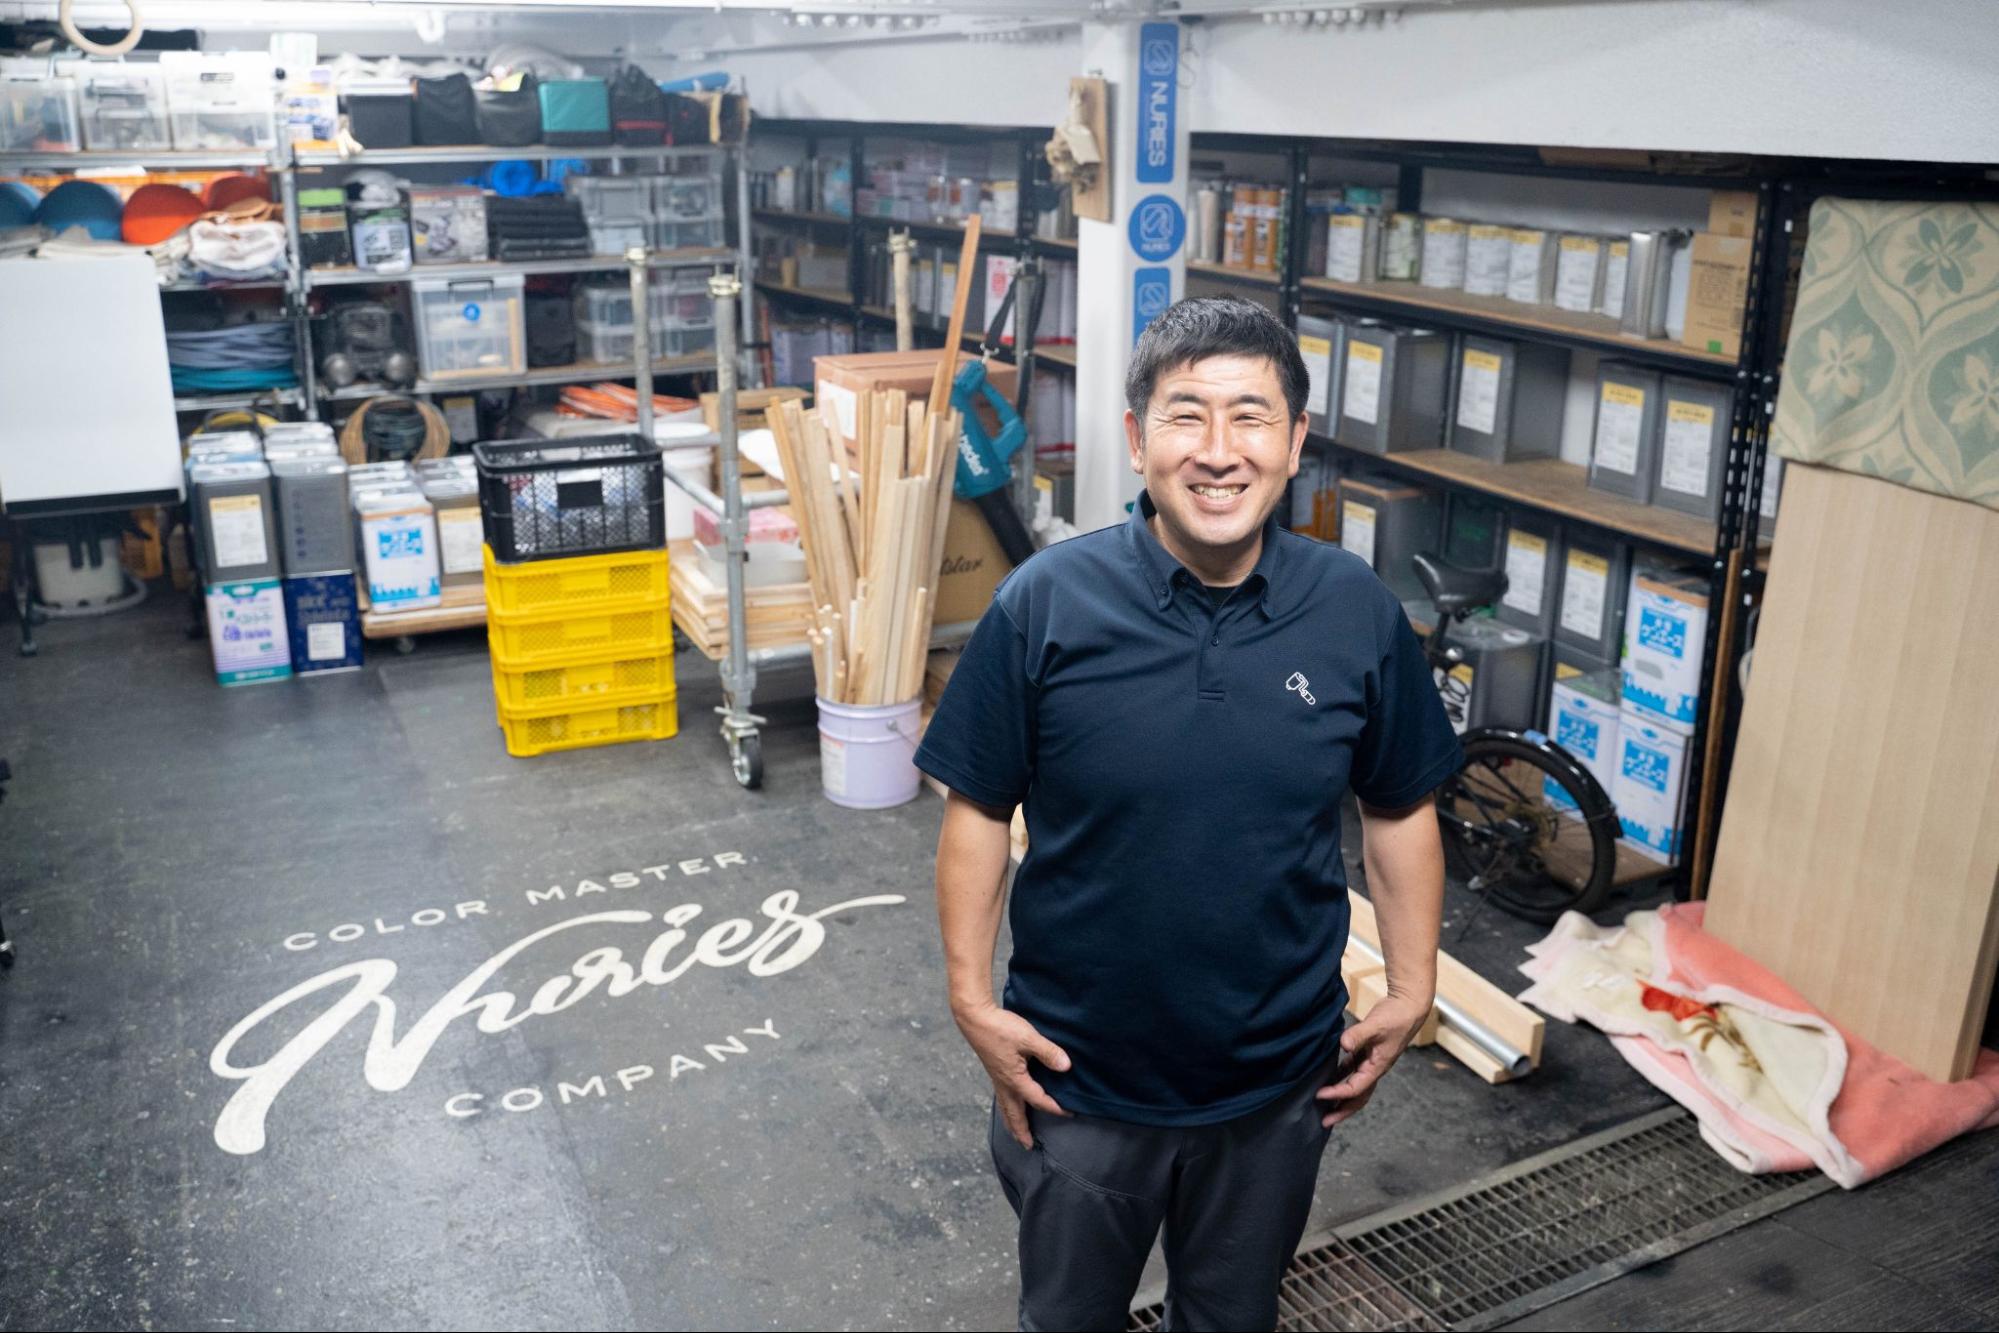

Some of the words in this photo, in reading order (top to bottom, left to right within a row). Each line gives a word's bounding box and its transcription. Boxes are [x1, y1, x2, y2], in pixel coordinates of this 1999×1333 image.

[1147, 80, 1169, 168] NURIES
[282, 899, 490, 952] COLOR
[526, 851, 747, 907] MASTER
[443, 1017, 781, 1118] COMPANY
